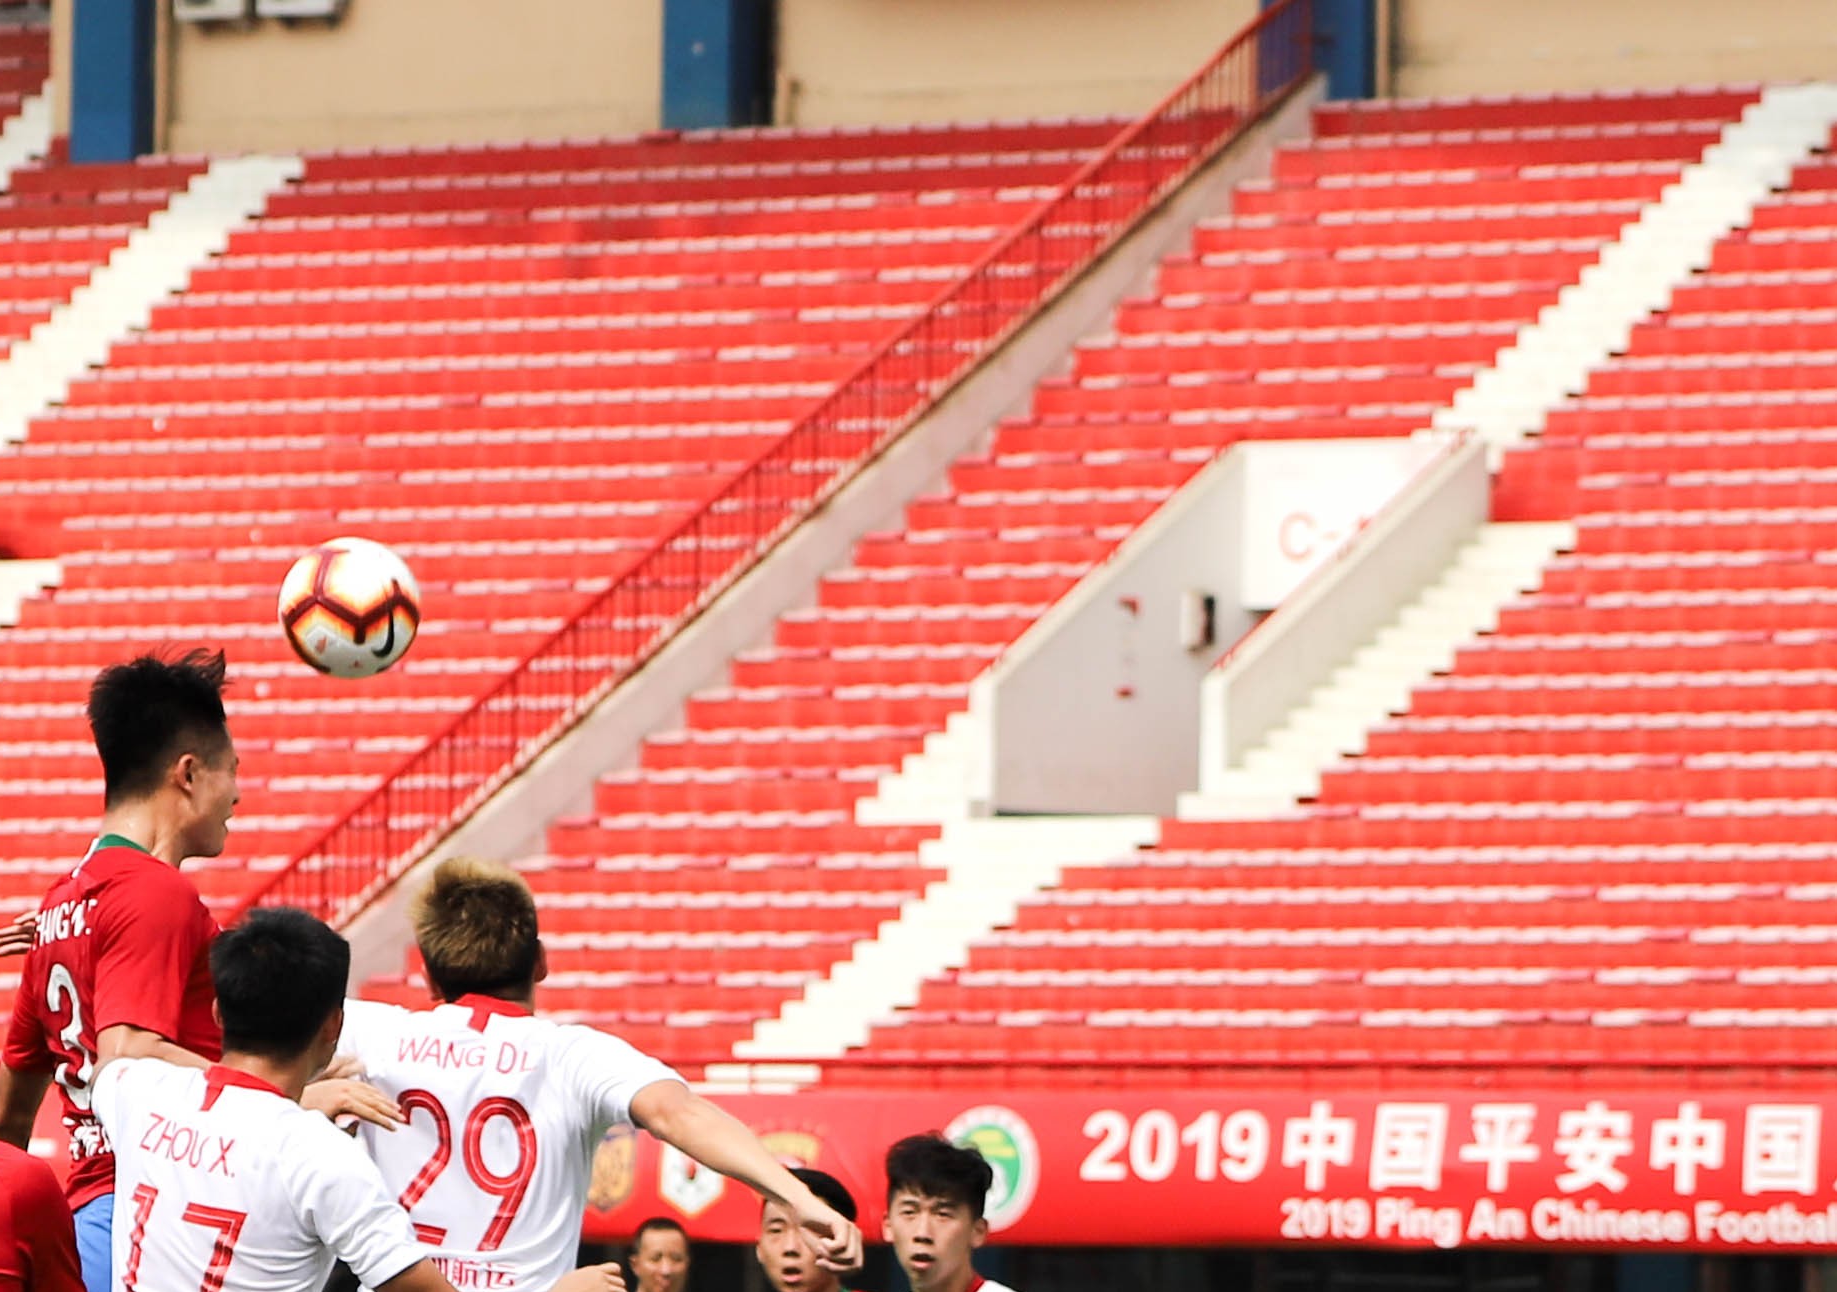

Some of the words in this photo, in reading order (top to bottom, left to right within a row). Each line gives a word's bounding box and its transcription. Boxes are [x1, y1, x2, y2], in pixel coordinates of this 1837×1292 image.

[47, 962, 94, 1110] 3
[397, 1036, 487, 1070] WANG
[139, 1111, 210, 1169] ZHOU
[208, 1135, 236, 1178] X.
[397, 1088, 538, 1252] 29
[1079, 1100, 1837, 1196] 2019中国平安中国
[1279, 1197, 1372, 1239] 2019
[1374, 1197, 1463, 1249] Ping
[1466, 1197, 1527, 1241] An
[1530, 1197, 1691, 1244] Chinese
